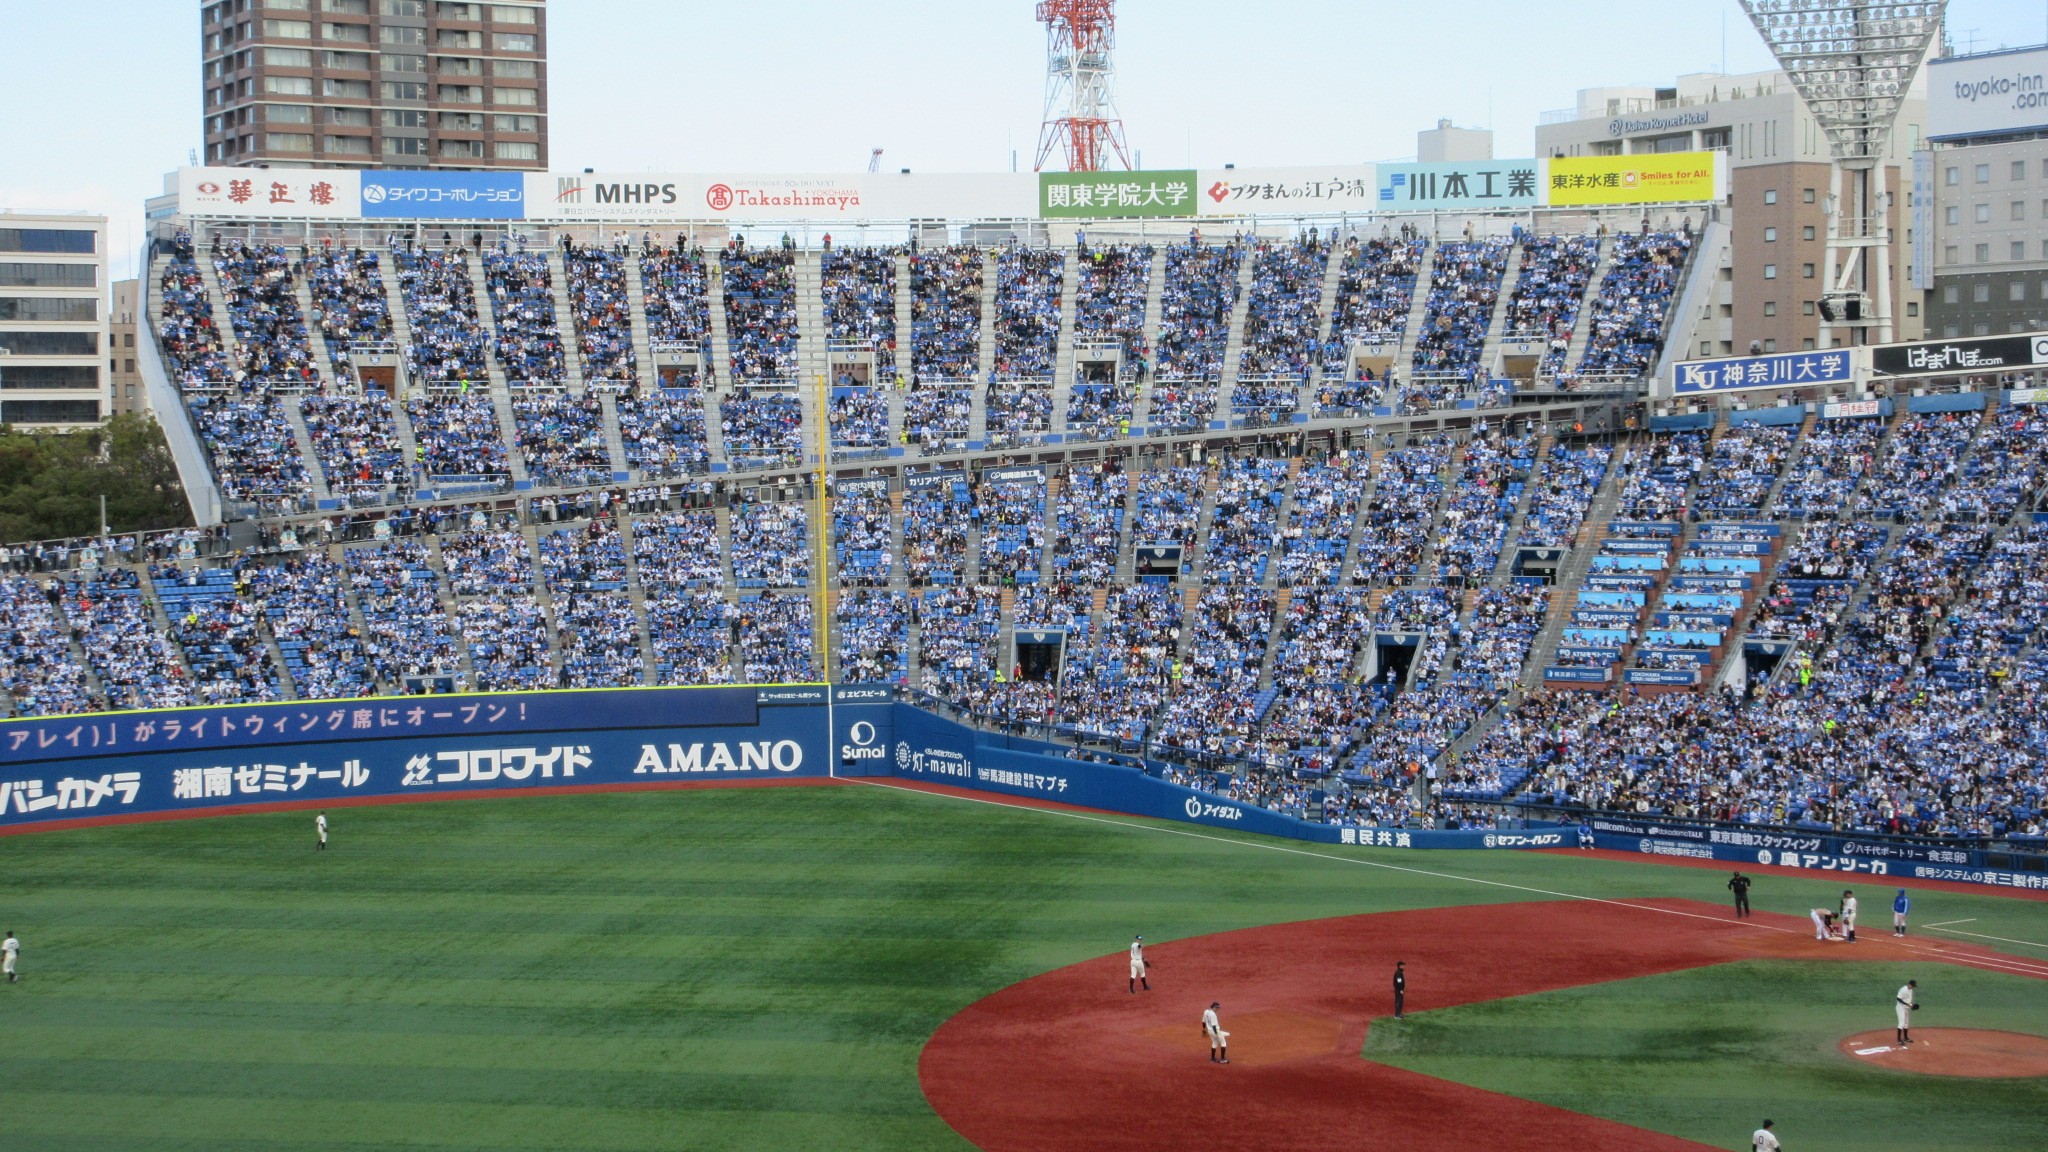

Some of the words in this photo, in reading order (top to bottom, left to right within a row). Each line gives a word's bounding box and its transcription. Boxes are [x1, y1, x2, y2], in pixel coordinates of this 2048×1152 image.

[1955, 73, 2043, 102] toyoko-inn
[1625, 120, 1649, 132] Daiwa
[1651, 116, 1682, 130] Roynet
[1683, 111, 1709, 124] Hotel
[1409, 169, 1535, 200] 川本工業
[1551, 173, 1620, 190] 東洋水産
[1640, 172, 1673, 181] Smiles
[1676, 171, 1691, 180] for
[1693, 169, 1710, 179] All.
[595, 183, 677, 204] MHPS
[811, 189, 858, 197] YOKOHAMA
[1048, 182, 1188, 208] 関東学院大学
[1230, 176, 1365, 201] ブタまんの江戸清
[735, 189, 860, 211] Takashimaya
[1907, 345, 2003, 369] はまれぽ.com
[1722, 355, 1842, 386] 神奈川大学
[1839, 401, 1878, 417] 月桂冠
[633, 740, 803, 774] AMANO
[842, 744, 886, 760] Sumai
[436, 746, 594, 783] コロワイド
[173, 759, 371, 799] 湘南ゼミナール
[1033, 774, 1068, 793] マブチ
[0, 771, 142, 816] バシカメラ
[1203, 803, 1243, 820] アイダスト
[1341, 828, 1411, 848] 県民共済
[1709, 830, 1821, 852] 東京建物スタッフィング
[1855, 844, 1924, 859] 八千代ポートリー
[1780, 851, 1887, 875] 奥アンツーカ
